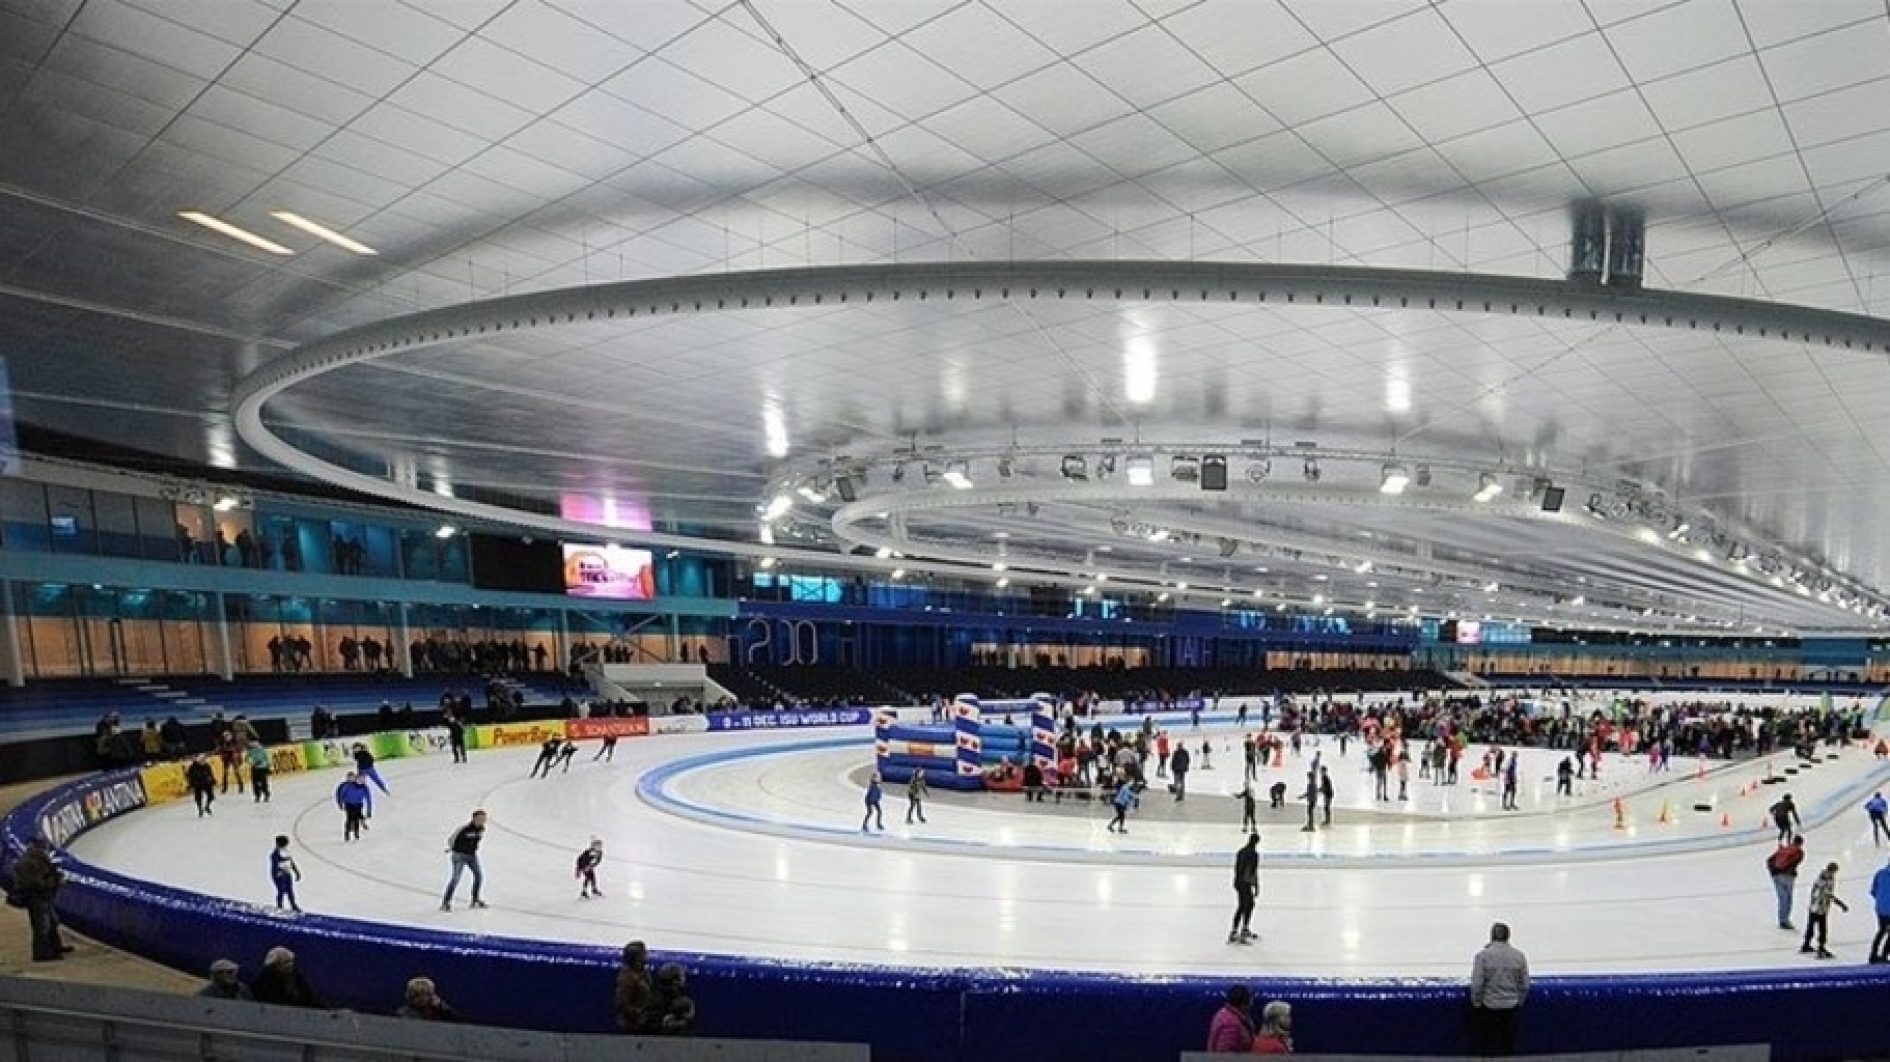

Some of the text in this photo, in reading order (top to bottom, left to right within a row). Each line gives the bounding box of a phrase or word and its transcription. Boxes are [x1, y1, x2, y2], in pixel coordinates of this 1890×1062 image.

[780, 713, 798, 725] ISU
[801, 711, 837, 724] WORLD
[840, 710, 860, 723] CUP
